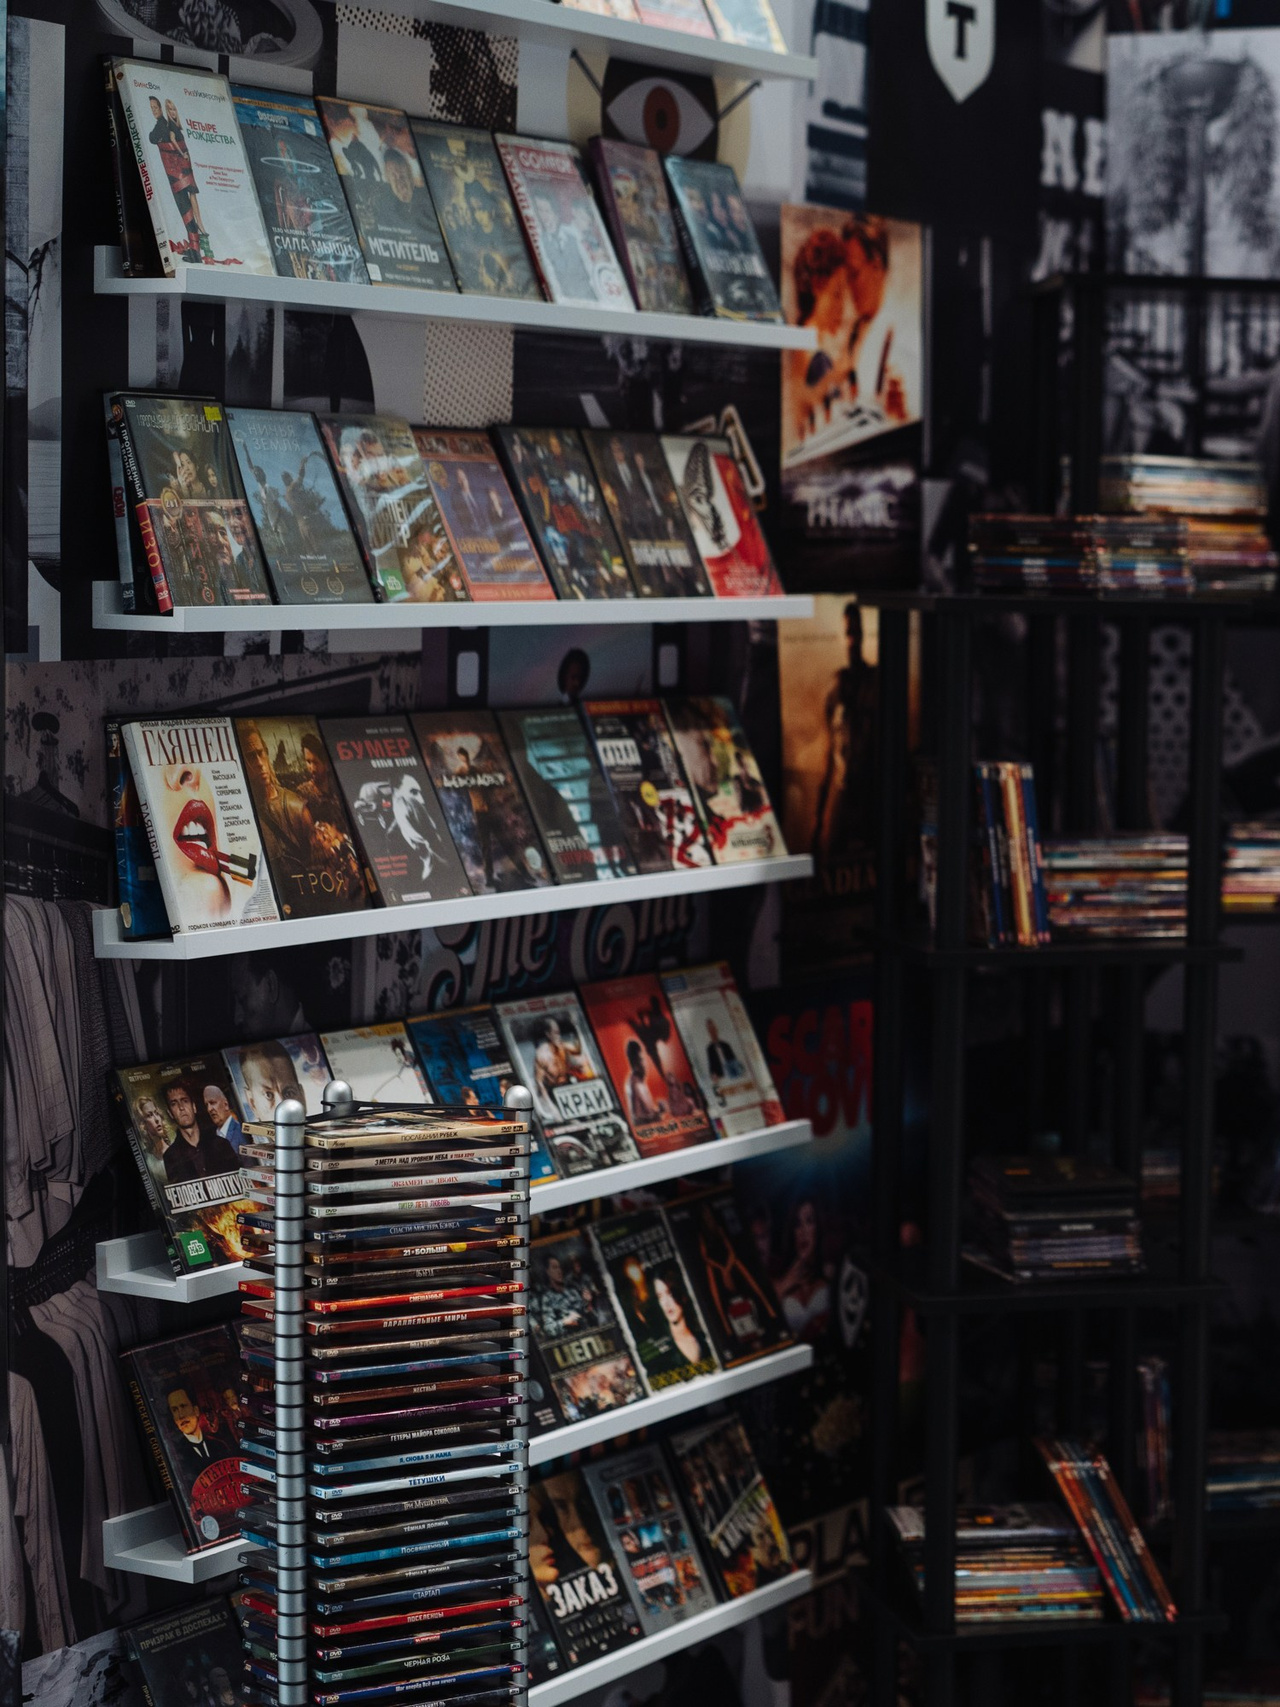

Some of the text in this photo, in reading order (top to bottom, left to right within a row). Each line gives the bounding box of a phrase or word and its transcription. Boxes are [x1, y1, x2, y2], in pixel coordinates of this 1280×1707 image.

[185, 119, 218, 133] ЧЕТЫРЕ
[186, 128, 236, 146] РОЖДЕСТВА
[367, 236, 440, 264] МСТИТЕЛЬ
[142, 726, 240, 772] ГЛЯНЕЦ
[336, 737, 411, 761] БУМЕР
[291, 872, 347, 897] ТРОЯ
[401, 1132, 438, 1142] ПОСЛЕДНИЙ
[410, 1155, 434, 1163] УРОВНЕМ
[391, 1179, 423, 1188] ЭКЗАМЕН
[430, 1199, 450, 1208] ЛЮБОВЬ
[390, 1226, 413, 1235] СПАСТИ
[414, 1223, 439, 1233] МИСТЕРА
[383, 1314, 468, 1328] ПАРАЛЛЕЛЬНЫЕ МИРЫ
[390, 1426, 460, 1441] ГЕТЕРЫ МАЙОРА СОКОЛОВА
[406, 1455, 424, 1463] СНОВА
[435, 1451, 452, 1459] МАМА
[413, 1588, 440, 1600] СТАРТАП
[548, 1561, 621, 1619] ЗАКАЗ
[407, 1612, 444, 1623] ПОСЕЛЕНЦЫ
[140, 1630, 175, 1651] ПРИЗРАК
[182, 1614, 222, 1636] ДОСПЕХАХ
[404, 1654, 450, 1668] ЧЕРНАЯ РОЗА
